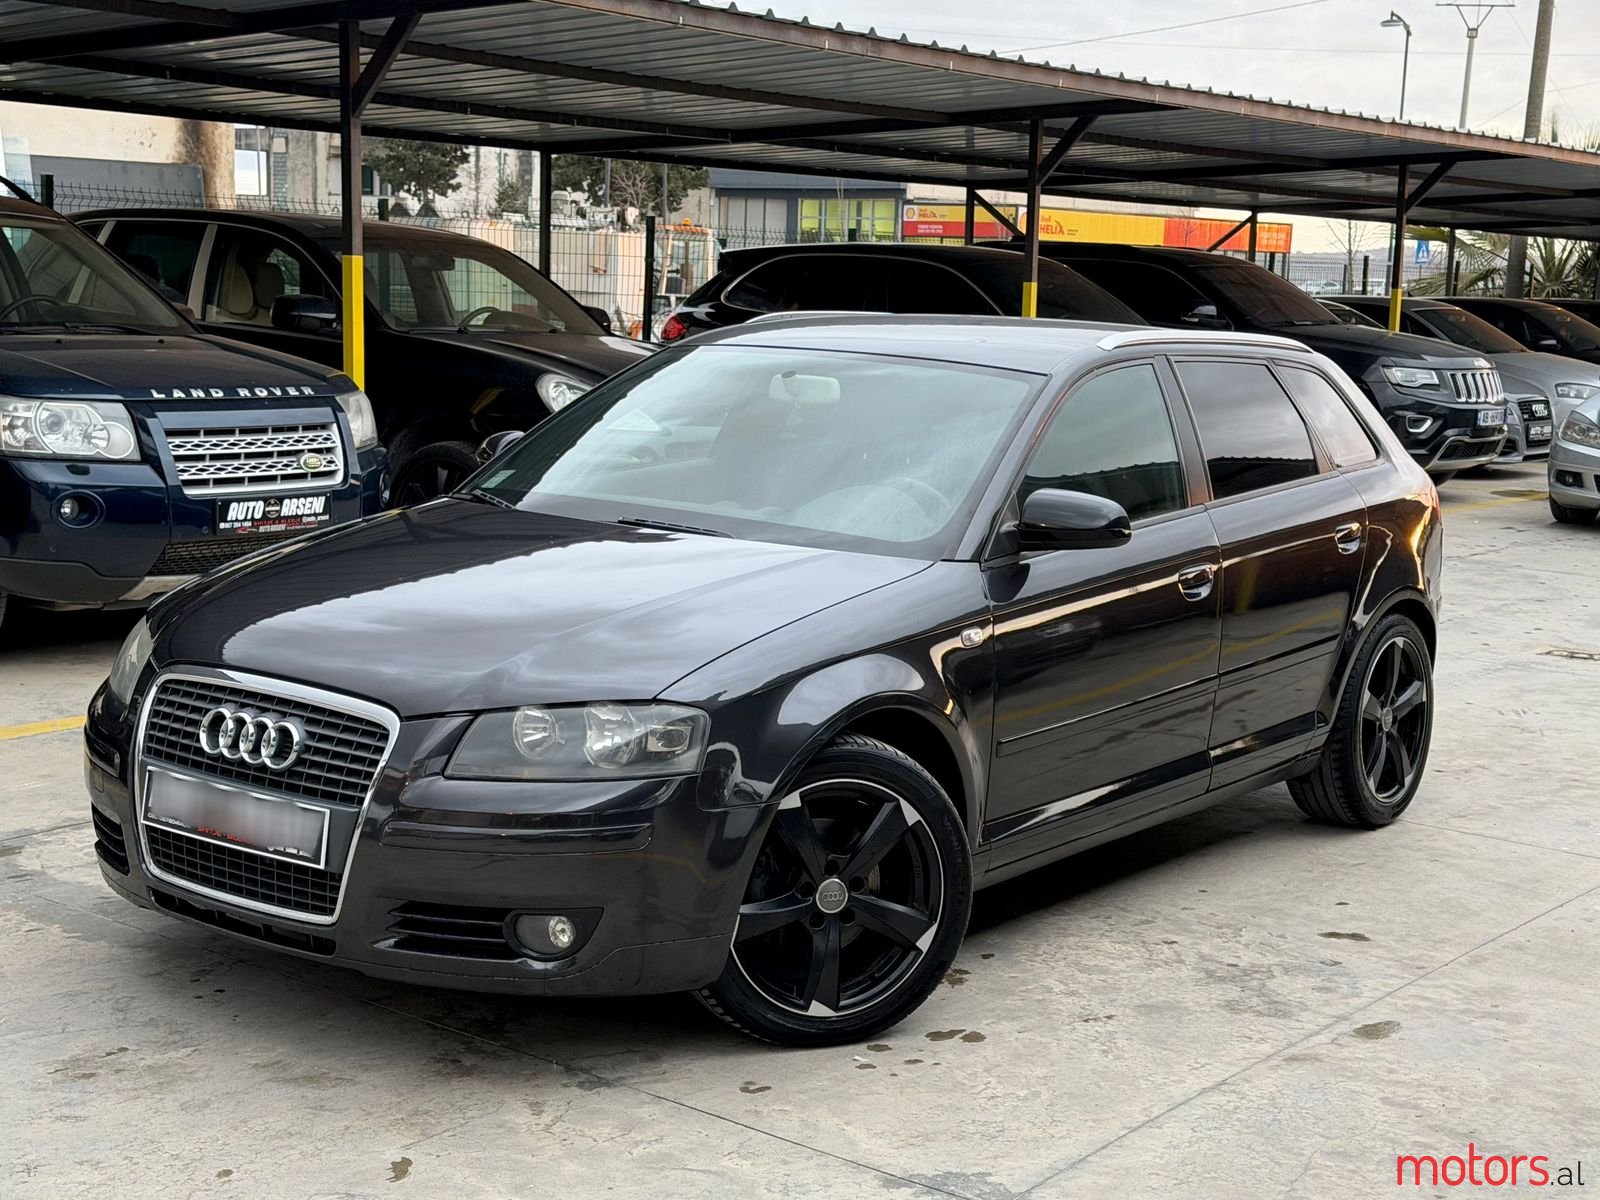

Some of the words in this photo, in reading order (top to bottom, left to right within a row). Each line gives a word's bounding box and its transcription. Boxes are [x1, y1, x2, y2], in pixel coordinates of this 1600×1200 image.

[1039, 219, 1066, 236] HELIX
[150, 388, 224, 399] LAND
[236, 386, 315, 397] ROVER
[227, 501, 264, 521] AUTO
[280, 496, 326, 517] ARSENI
